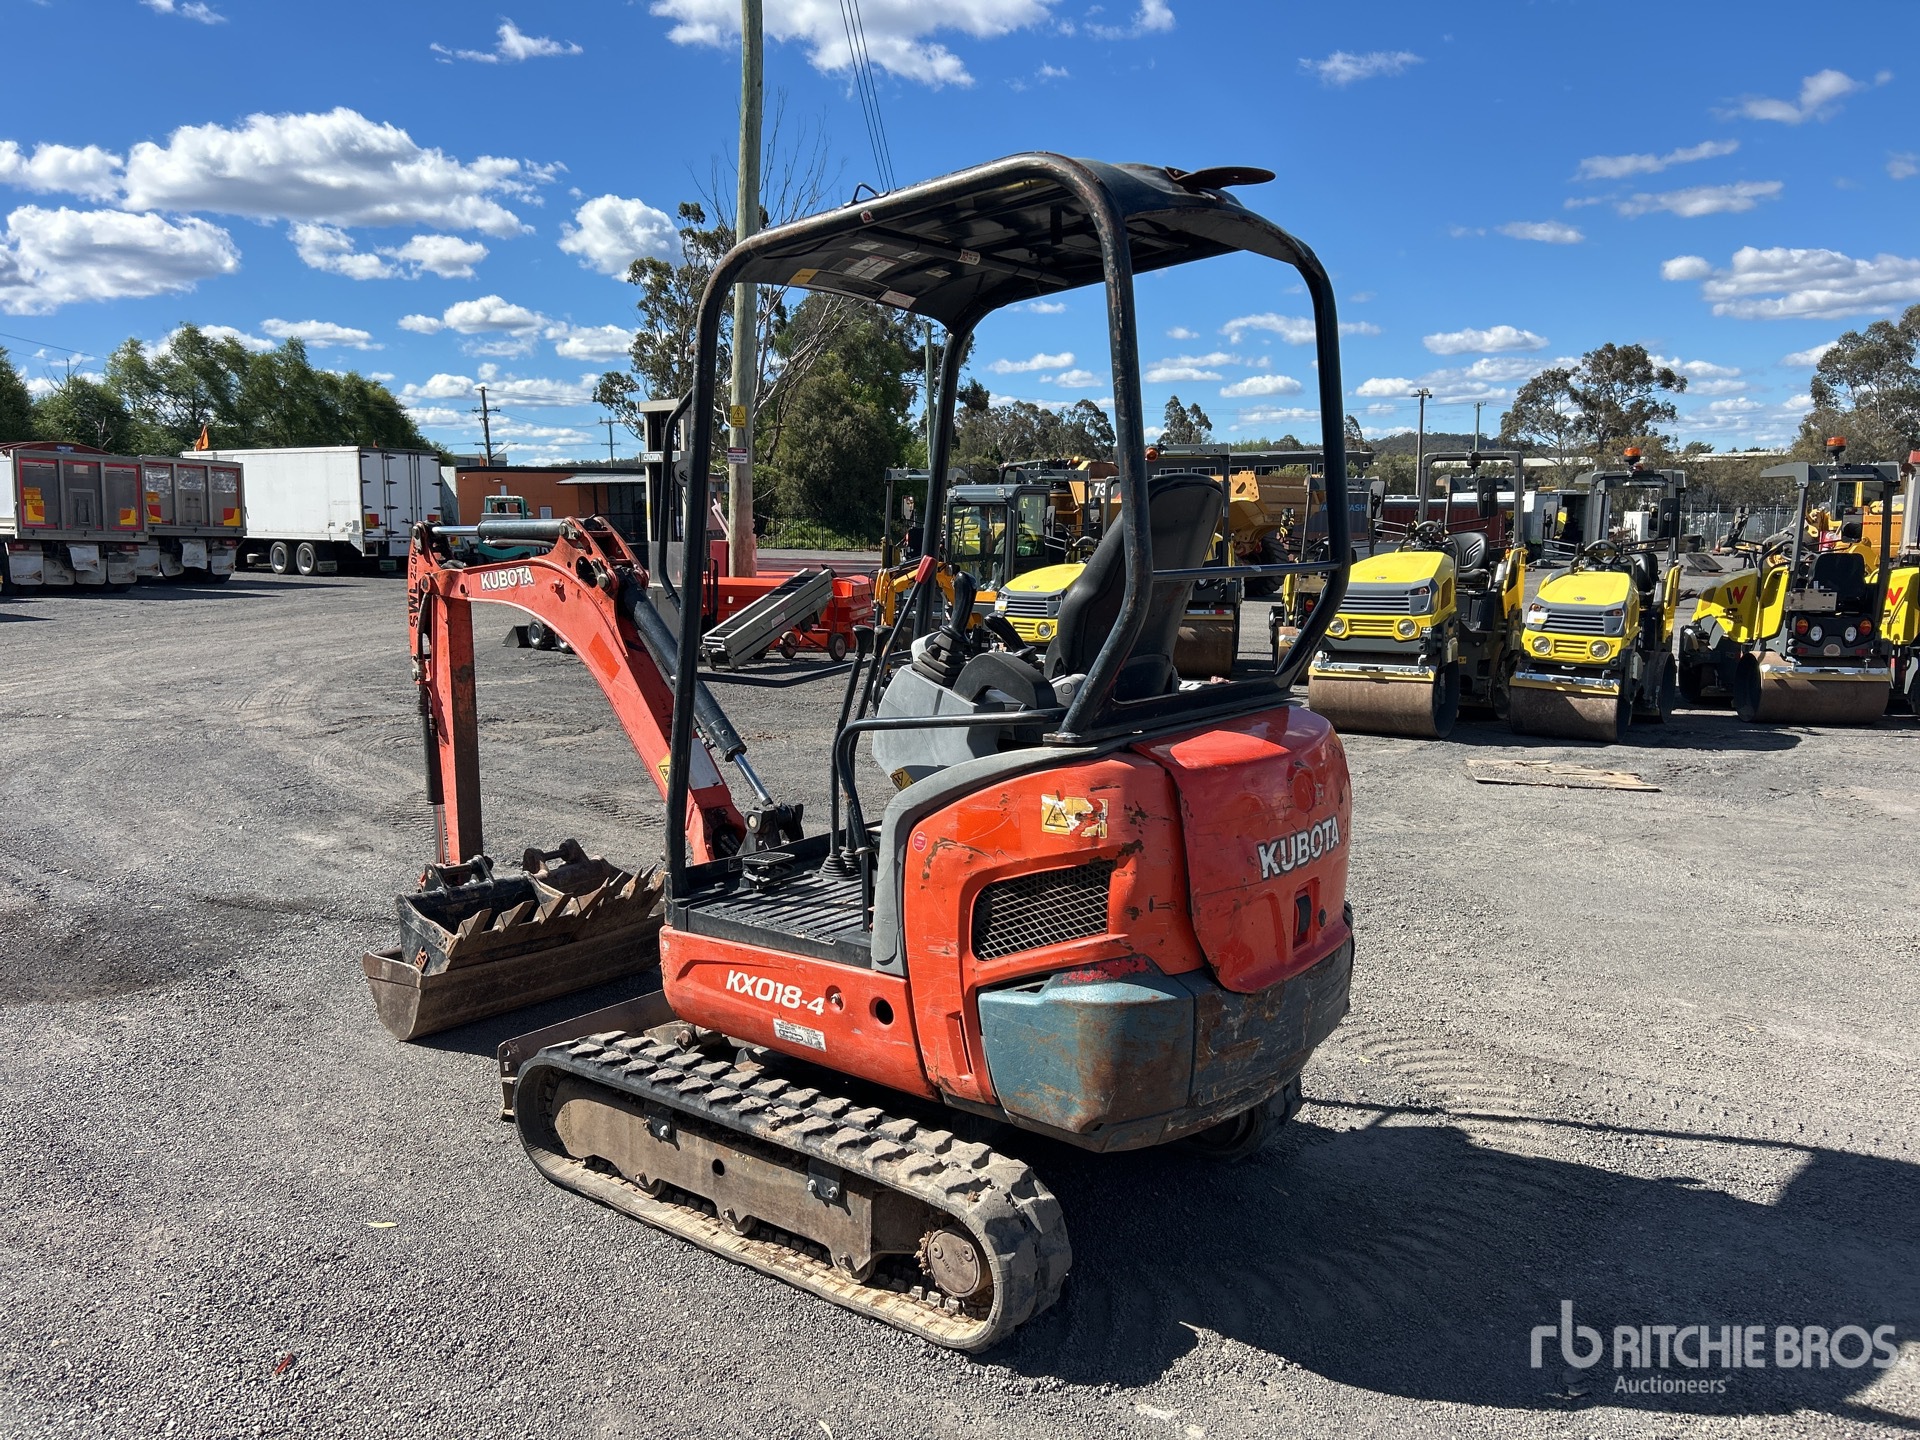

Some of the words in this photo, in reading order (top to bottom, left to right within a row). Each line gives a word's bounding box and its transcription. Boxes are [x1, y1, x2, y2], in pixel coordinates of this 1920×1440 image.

[480, 565, 534, 590] KUBOTA
[409, 582, 419, 628] SWL
[1257, 815, 1340, 880] KUBOTA
[725, 968, 825, 1017] KX018-4
